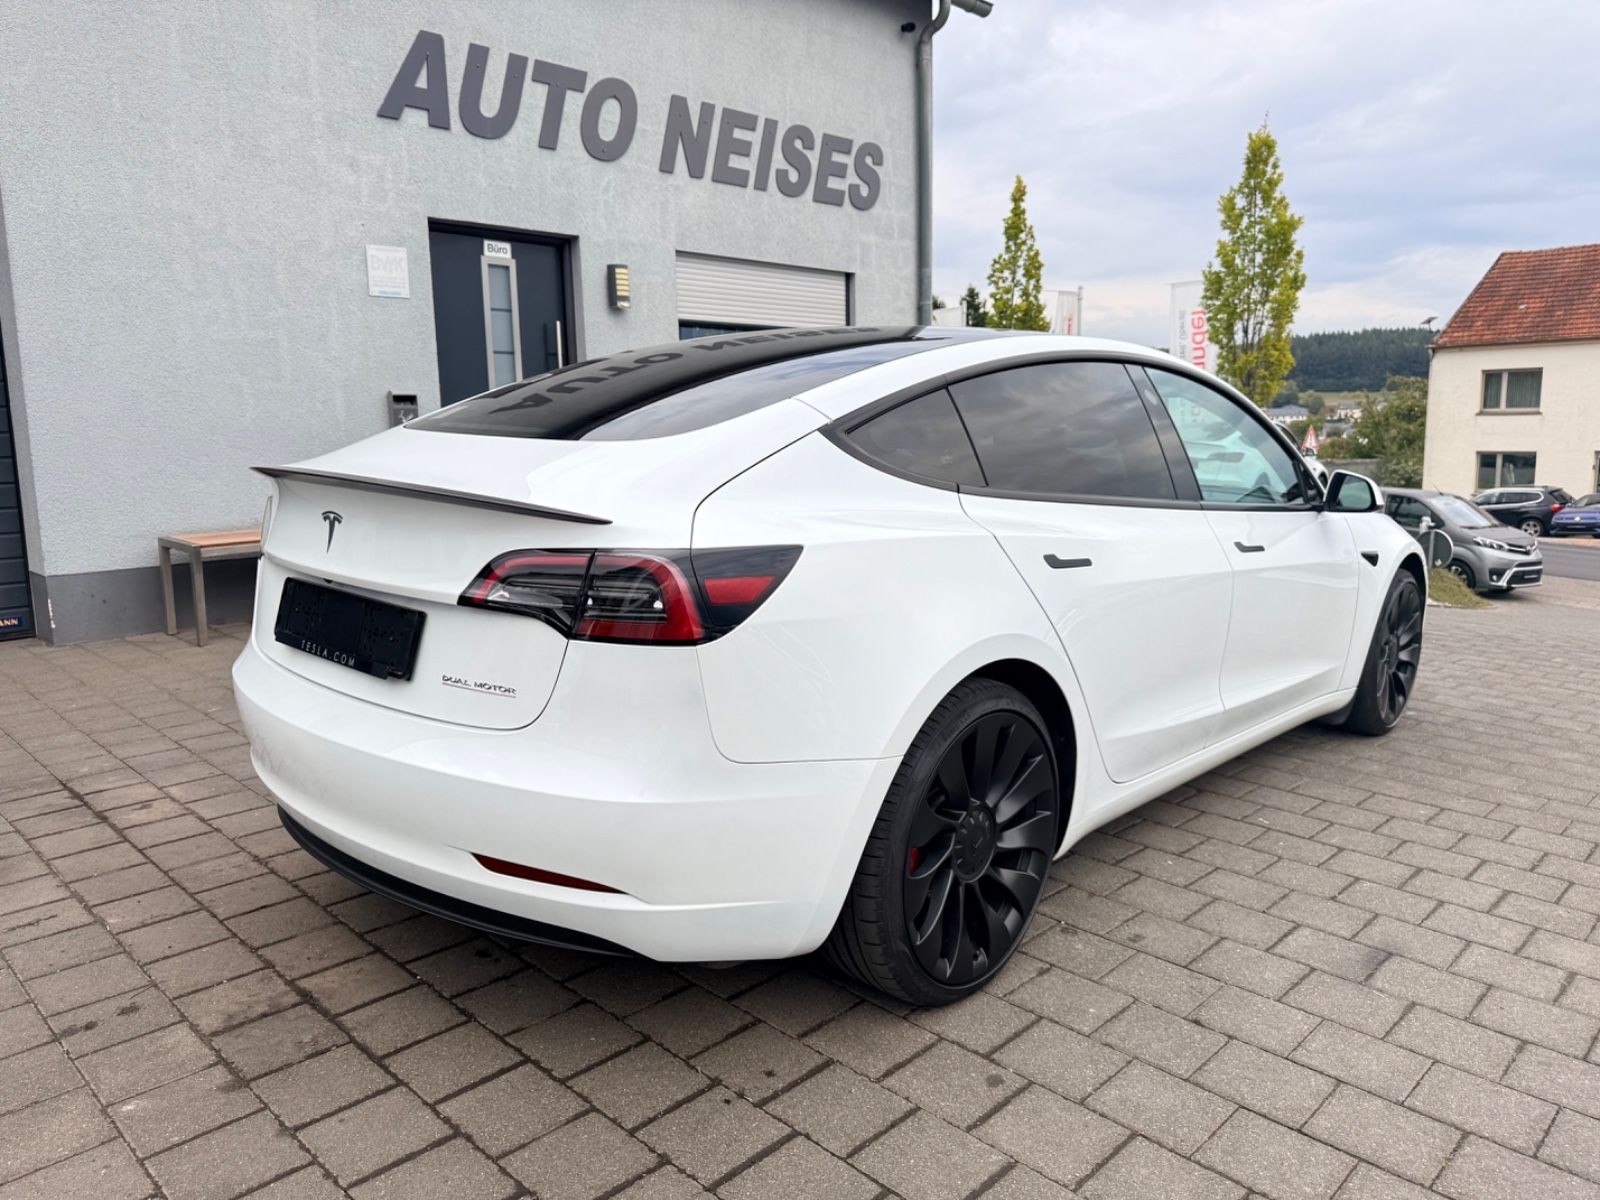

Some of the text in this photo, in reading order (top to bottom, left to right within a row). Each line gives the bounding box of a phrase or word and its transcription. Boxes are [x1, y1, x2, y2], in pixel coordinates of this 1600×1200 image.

[376, 29, 884, 211] AUTO NEISES
[487, 243, 508, 255] Büro
[301, 639, 355, 667] TESLA.COM
[441, 674, 517, 695] DUAL MOTOR
